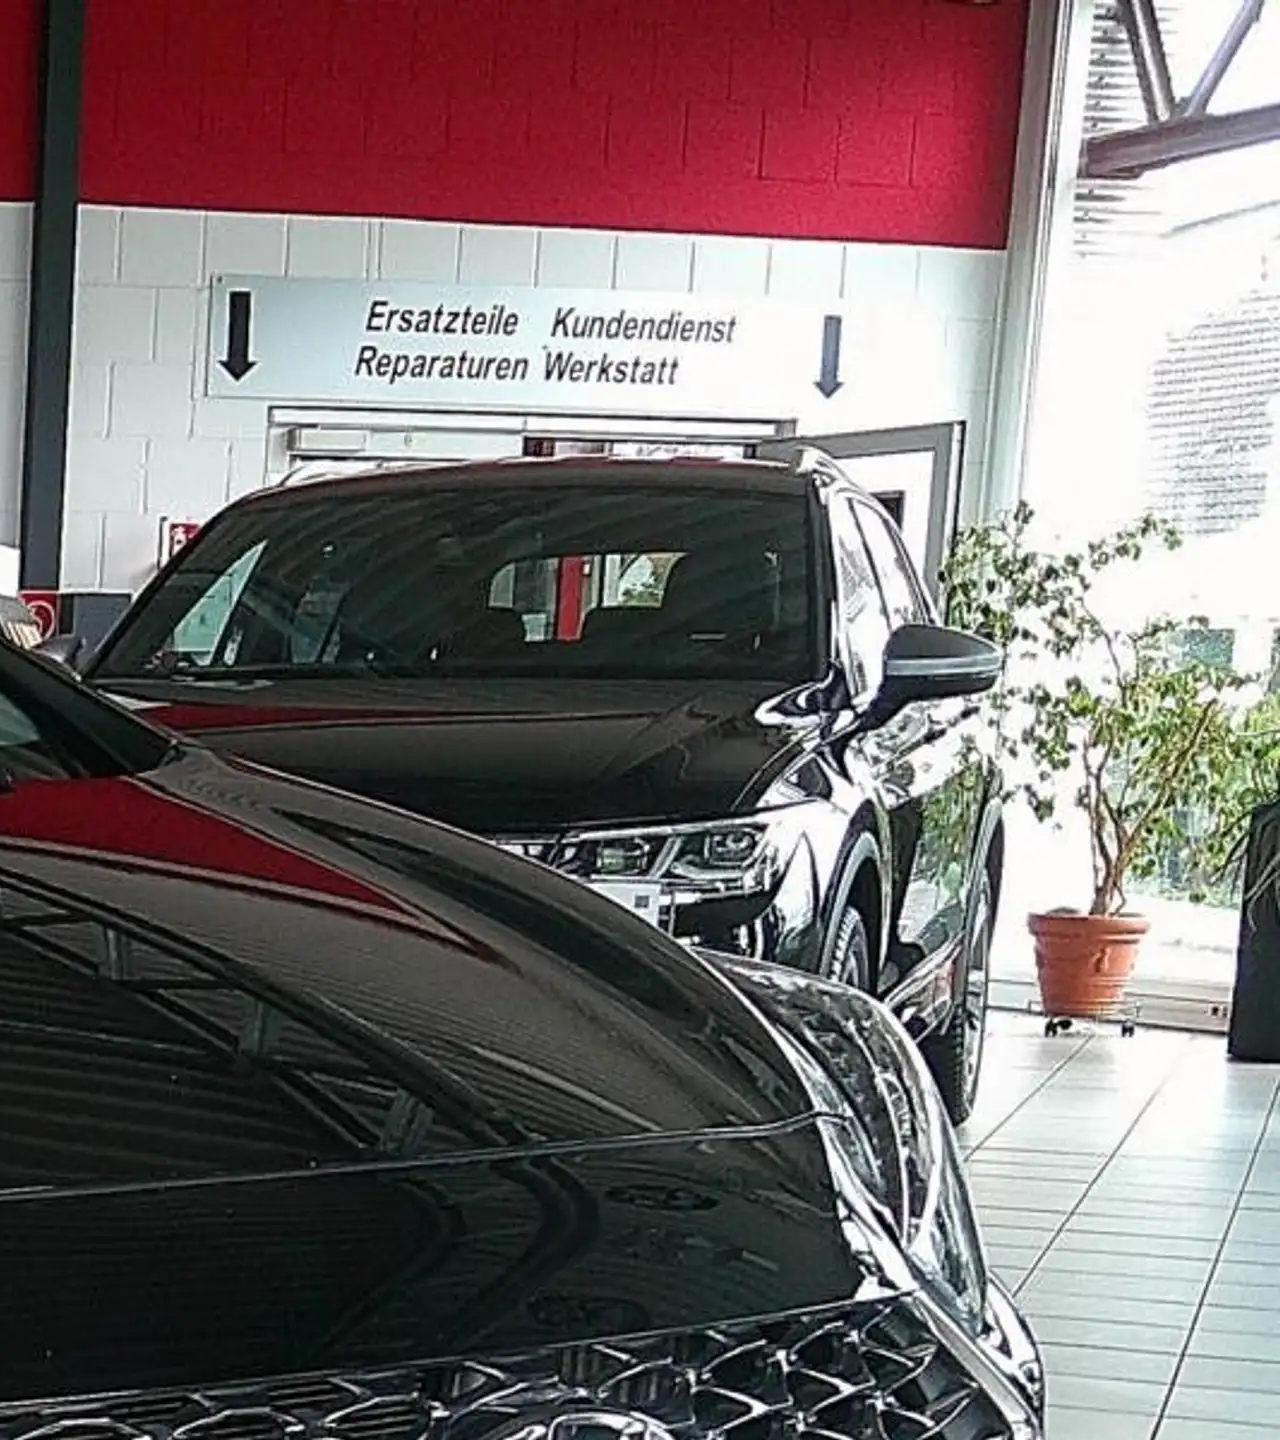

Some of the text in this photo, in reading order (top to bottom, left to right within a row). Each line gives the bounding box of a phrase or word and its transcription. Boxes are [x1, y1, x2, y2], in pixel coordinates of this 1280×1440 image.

[365, 300, 737, 343] Ersatzteile Kundendienst
[355, 345, 678, 385] Reparaturen Werkstatt
